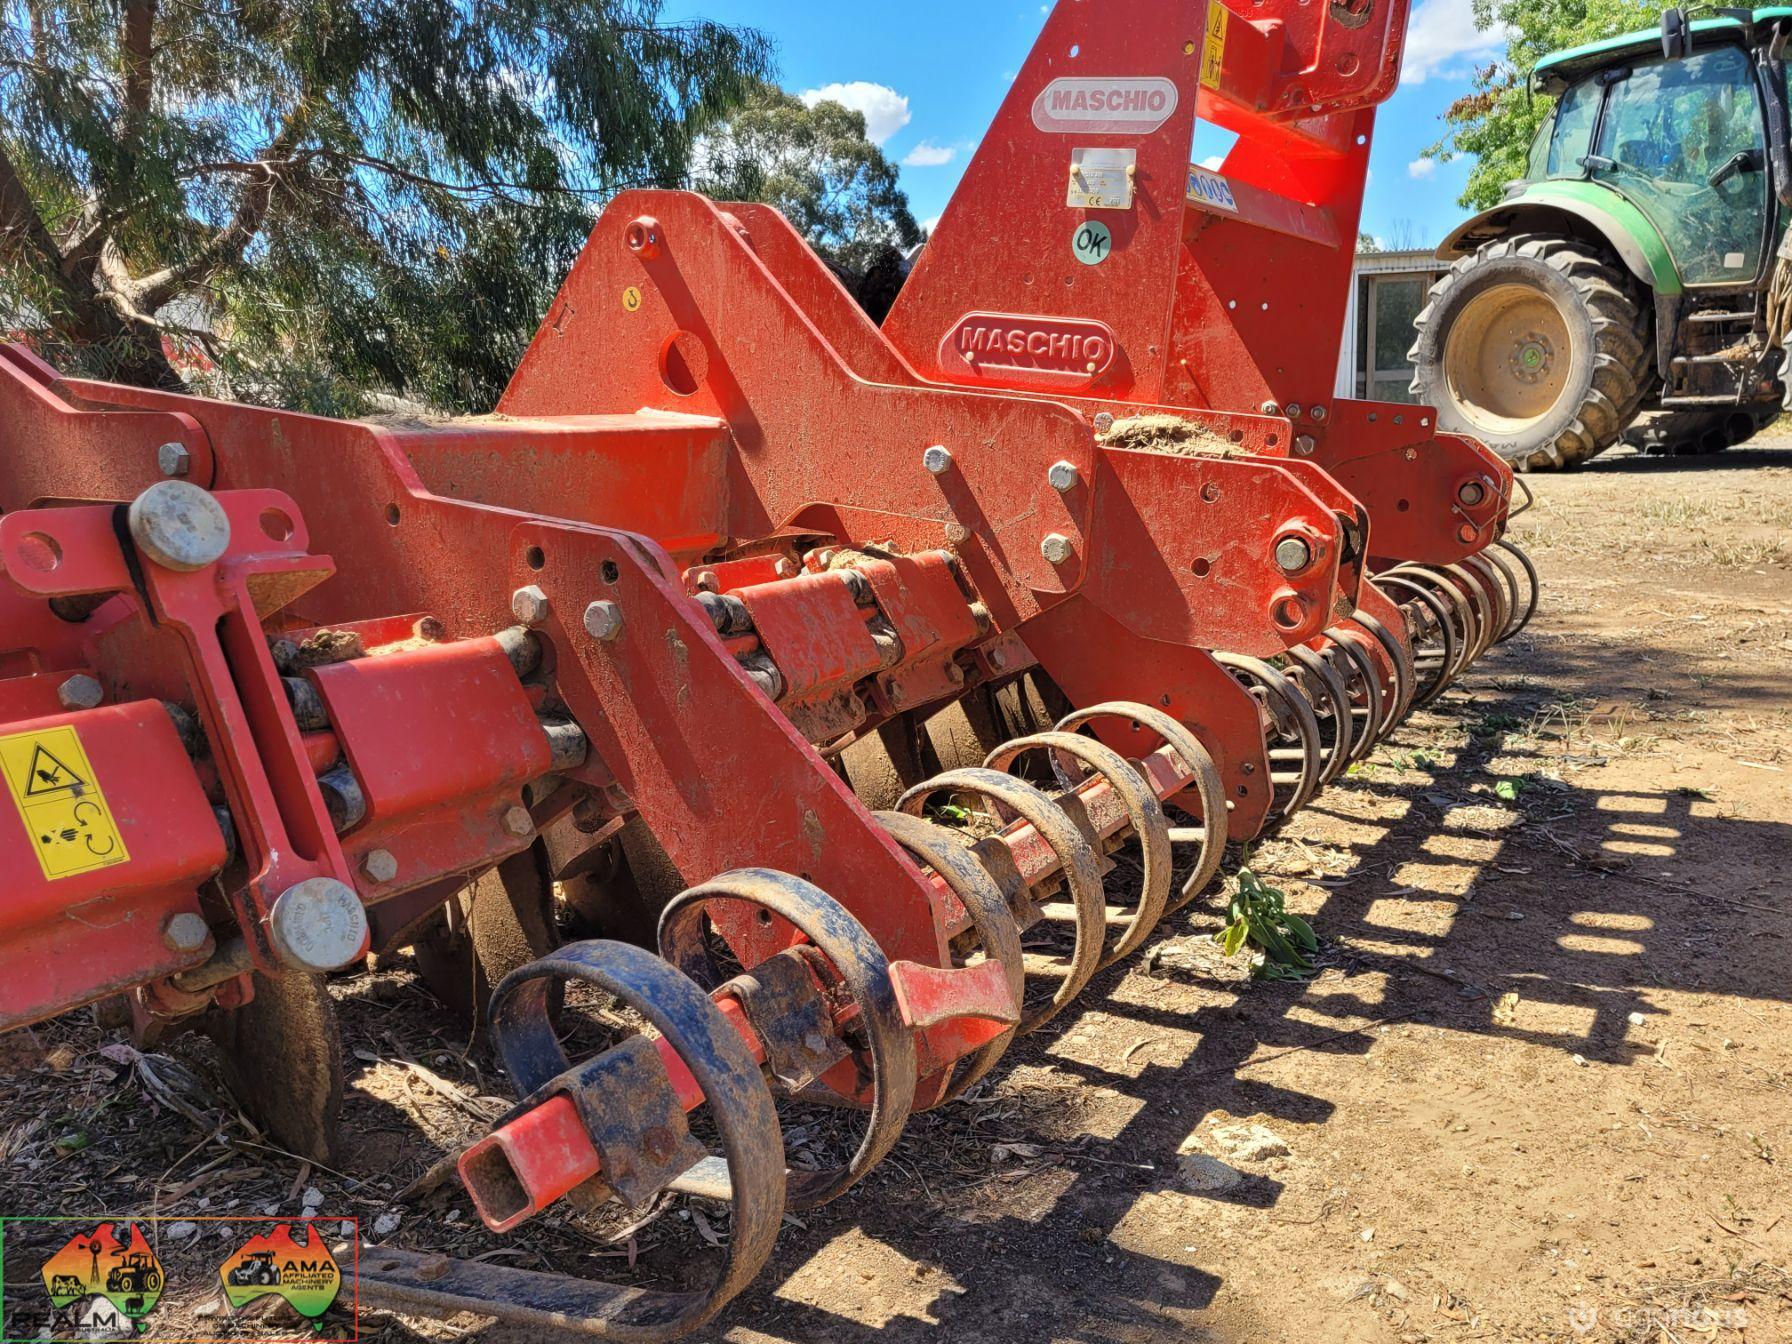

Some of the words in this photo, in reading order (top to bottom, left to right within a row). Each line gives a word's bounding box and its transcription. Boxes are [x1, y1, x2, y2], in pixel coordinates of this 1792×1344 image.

[1051, 89, 1166, 112] MASCHIO
[1077, 228, 1107, 258] OK
[961, 326, 1105, 360] MASCHIO
